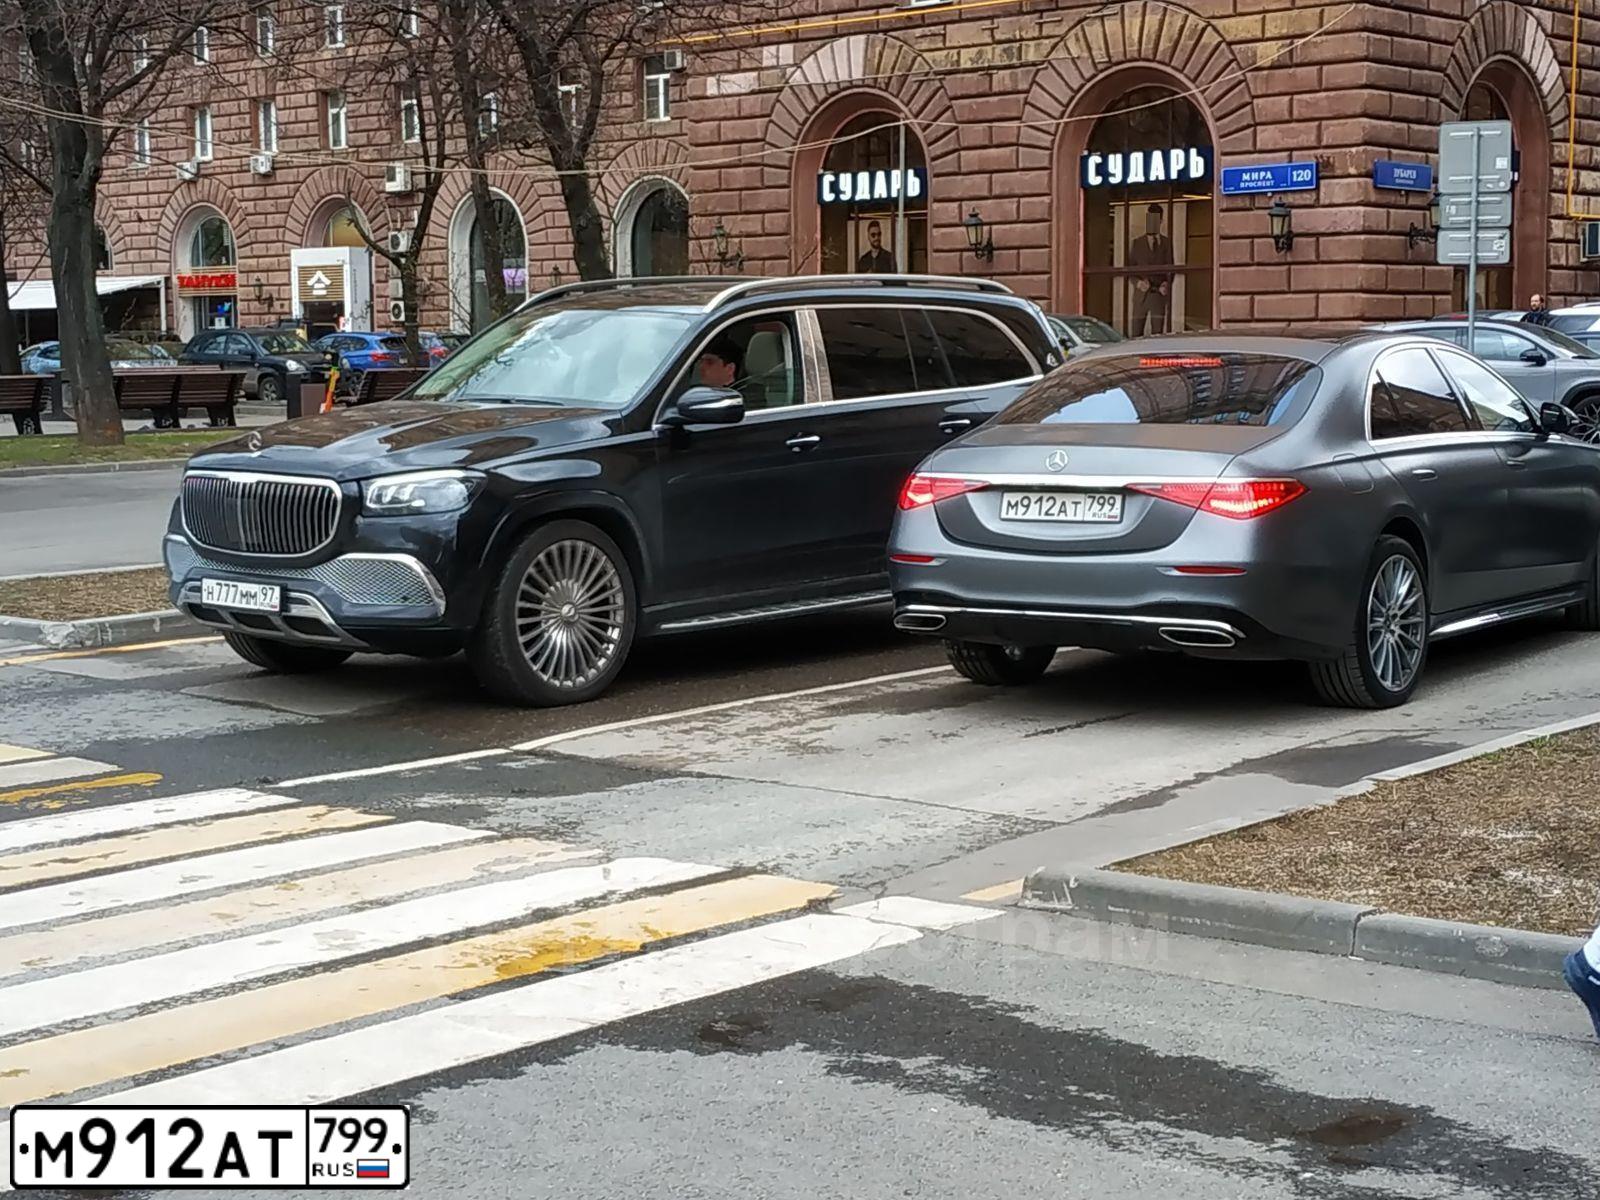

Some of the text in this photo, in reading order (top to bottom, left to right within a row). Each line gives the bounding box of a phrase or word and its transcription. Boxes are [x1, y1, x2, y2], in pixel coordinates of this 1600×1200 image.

[1086, 147, 1205, 186] СУДАРЬ
[1242, 169, 1312, 182] МИРА 120
[821, 168, 922, 202] СУДАРЬ
[1004, 495, 1117, 518] М912АТ 799
[206, 582, 275, 606] Н777ММ 97
